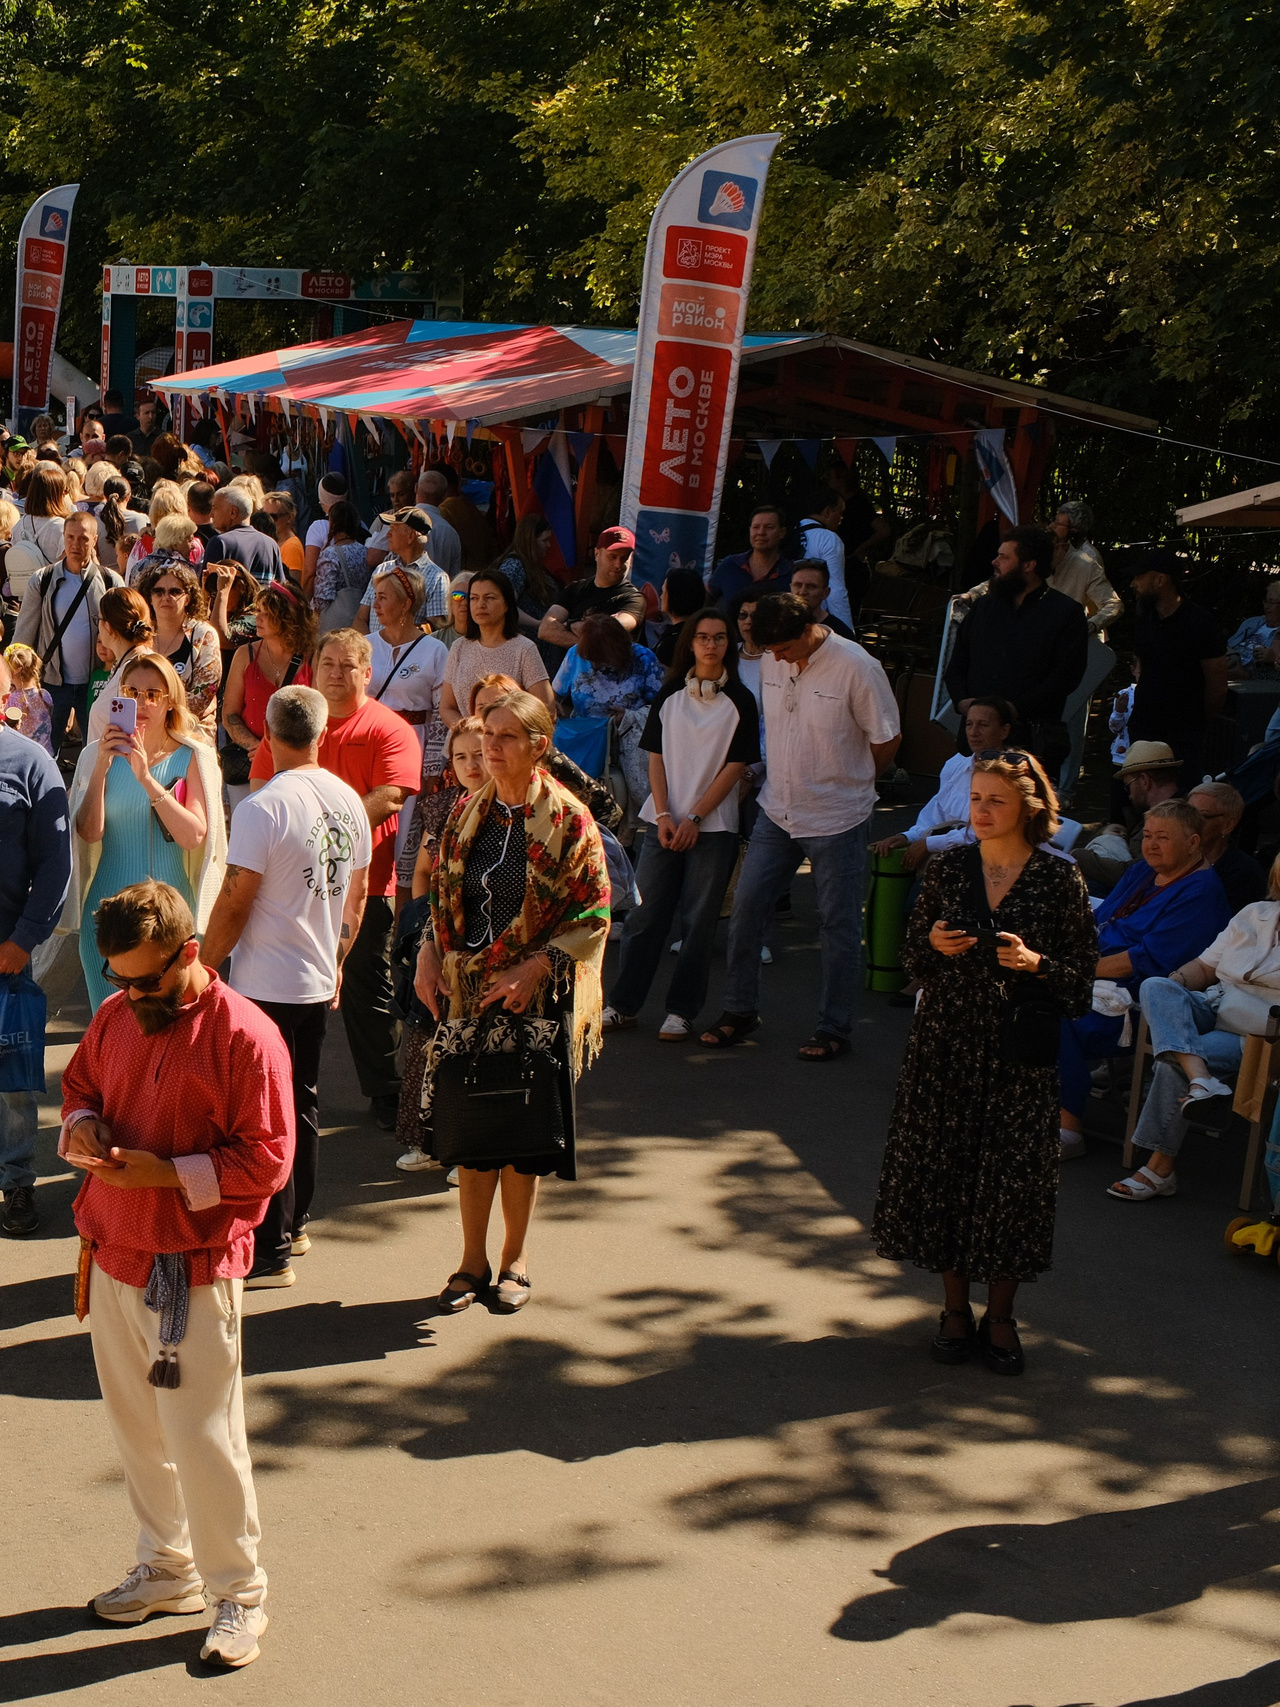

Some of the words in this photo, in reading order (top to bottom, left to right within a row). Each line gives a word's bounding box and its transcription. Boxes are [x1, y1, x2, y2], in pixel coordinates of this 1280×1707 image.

[704, 252, 724, 260] МЭРА
[705, 245, 732, 255] ПРОЕКТ
[703, 259, 734, 269] МОСКВЫ
[309, 276, 345, 287] ЛЕТО
[23, 320, 37, 393] ЛЕТО
[33, 322, 45, 381] МОСКВЕ
[33, 385, 39, 394] В
[691, 369, 714, 466] МОСКВЕ
[659, 366, 695, 485] ЛЕТО
[689, 473, 700, 488] В
